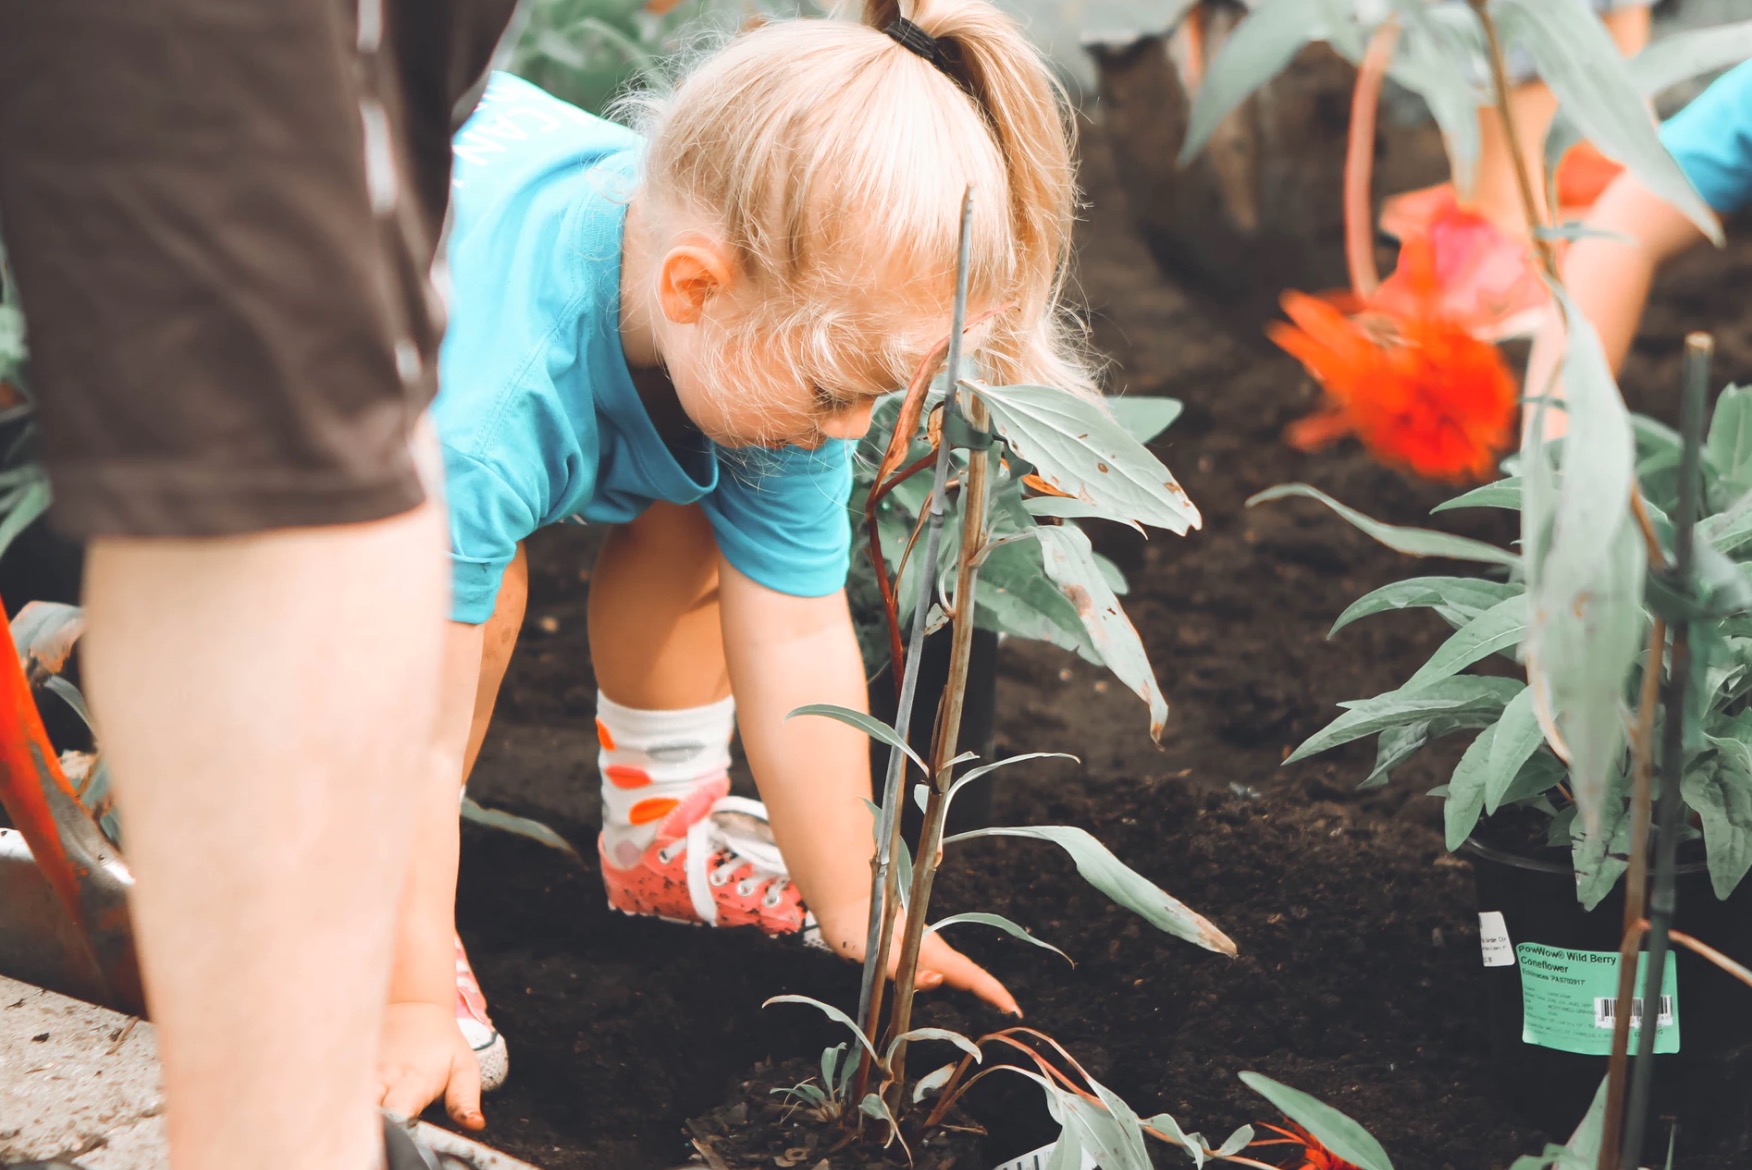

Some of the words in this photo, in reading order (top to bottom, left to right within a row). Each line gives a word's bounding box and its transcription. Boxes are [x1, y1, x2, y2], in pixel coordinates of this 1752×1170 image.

[1520, 956, 1569, 974] Coneflower
[1566, 952, 1587, 962] Wild
[1590, 954, 1617, 966] Berry
